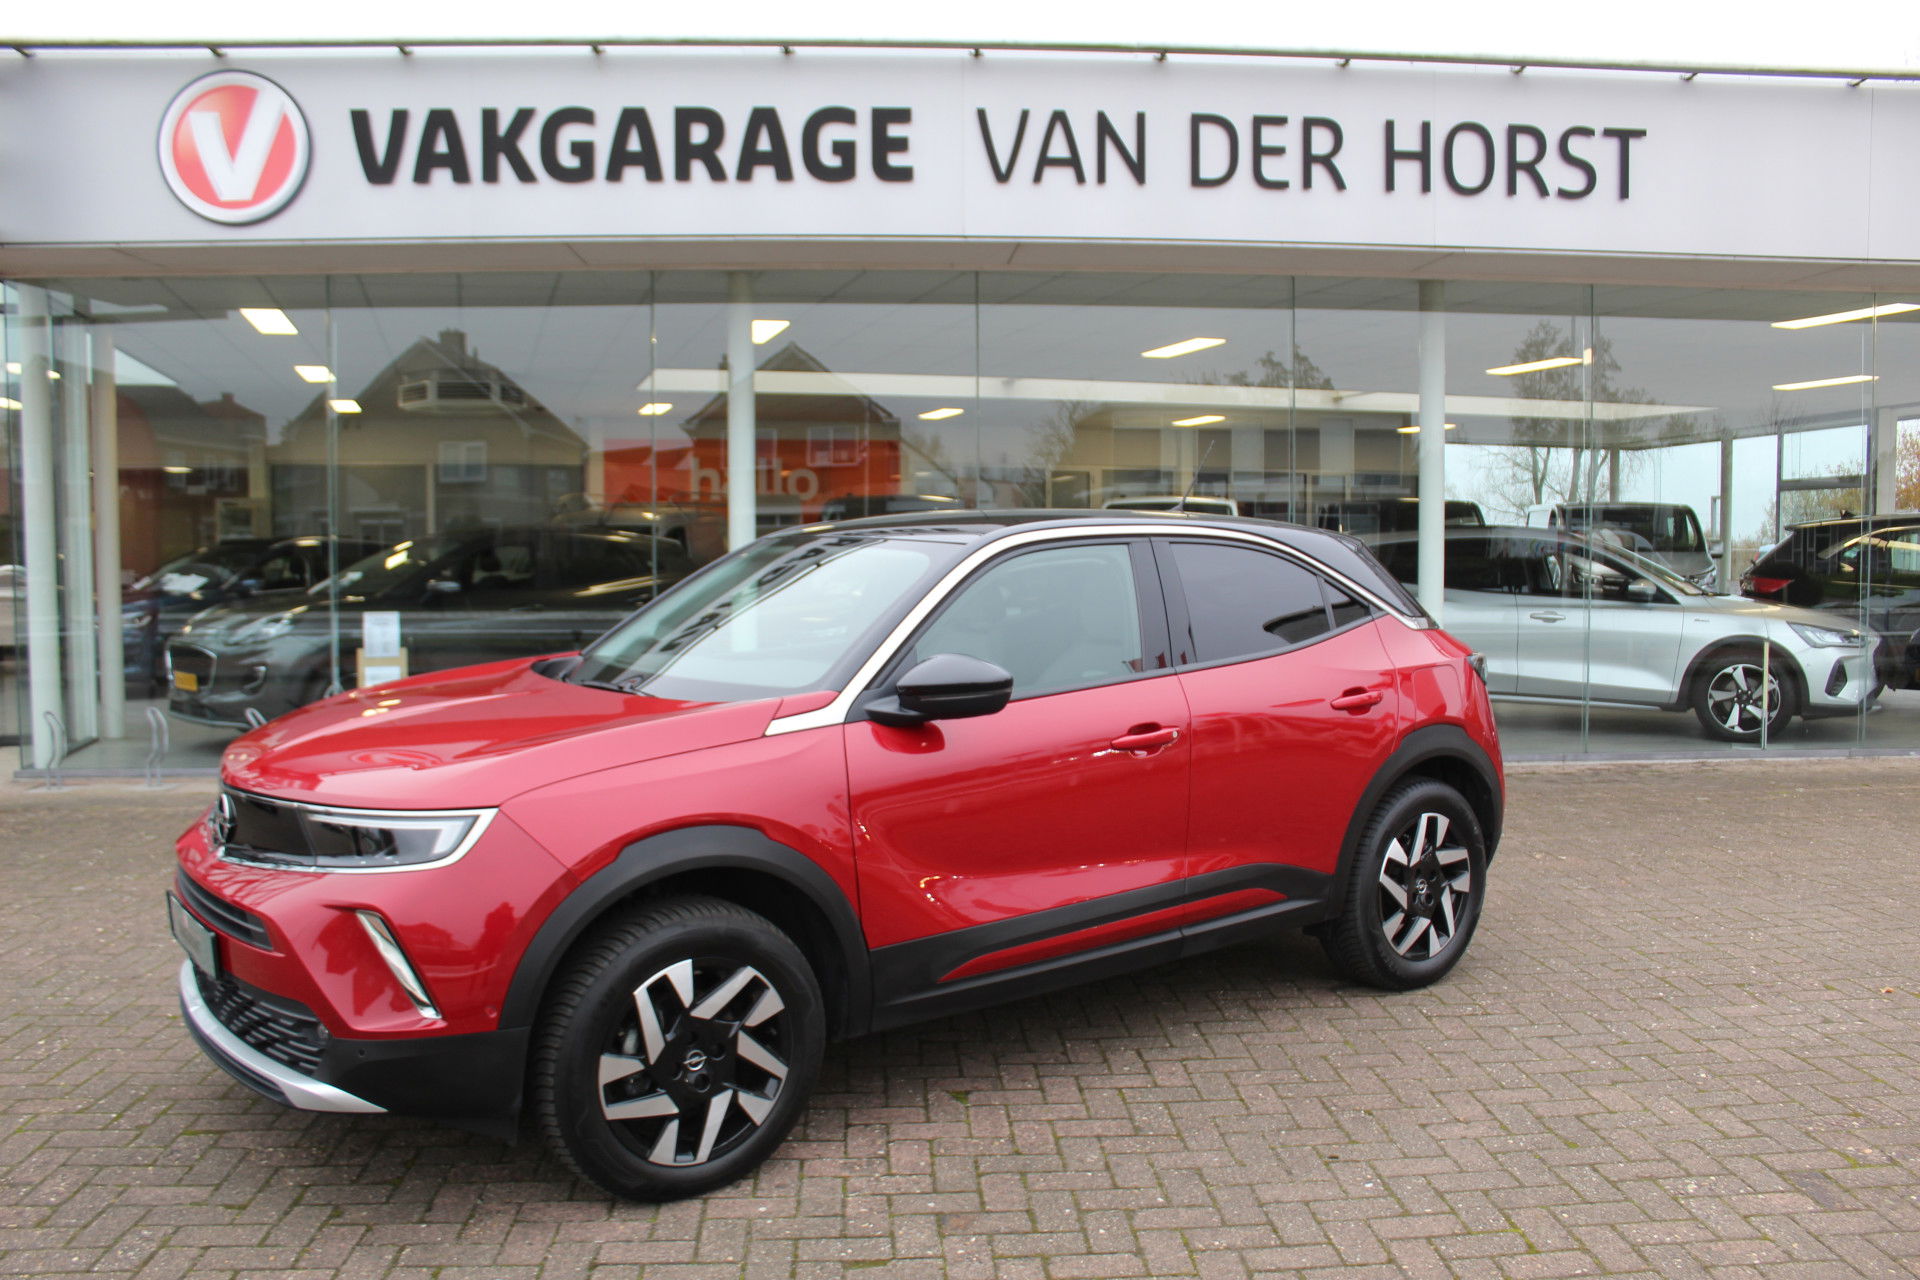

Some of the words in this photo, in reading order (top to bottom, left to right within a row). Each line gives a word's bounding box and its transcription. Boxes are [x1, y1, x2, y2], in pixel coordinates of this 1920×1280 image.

[188, 86, 286, 202] V
[349, 106, 914, 185] VAKGARAGE
[976, 108, 1146, 185] VAN
[1190, 113, 1347, 191] DER
[1385, 119, 1647, 201] HORST
[690, 456, 819, 500] hllo
